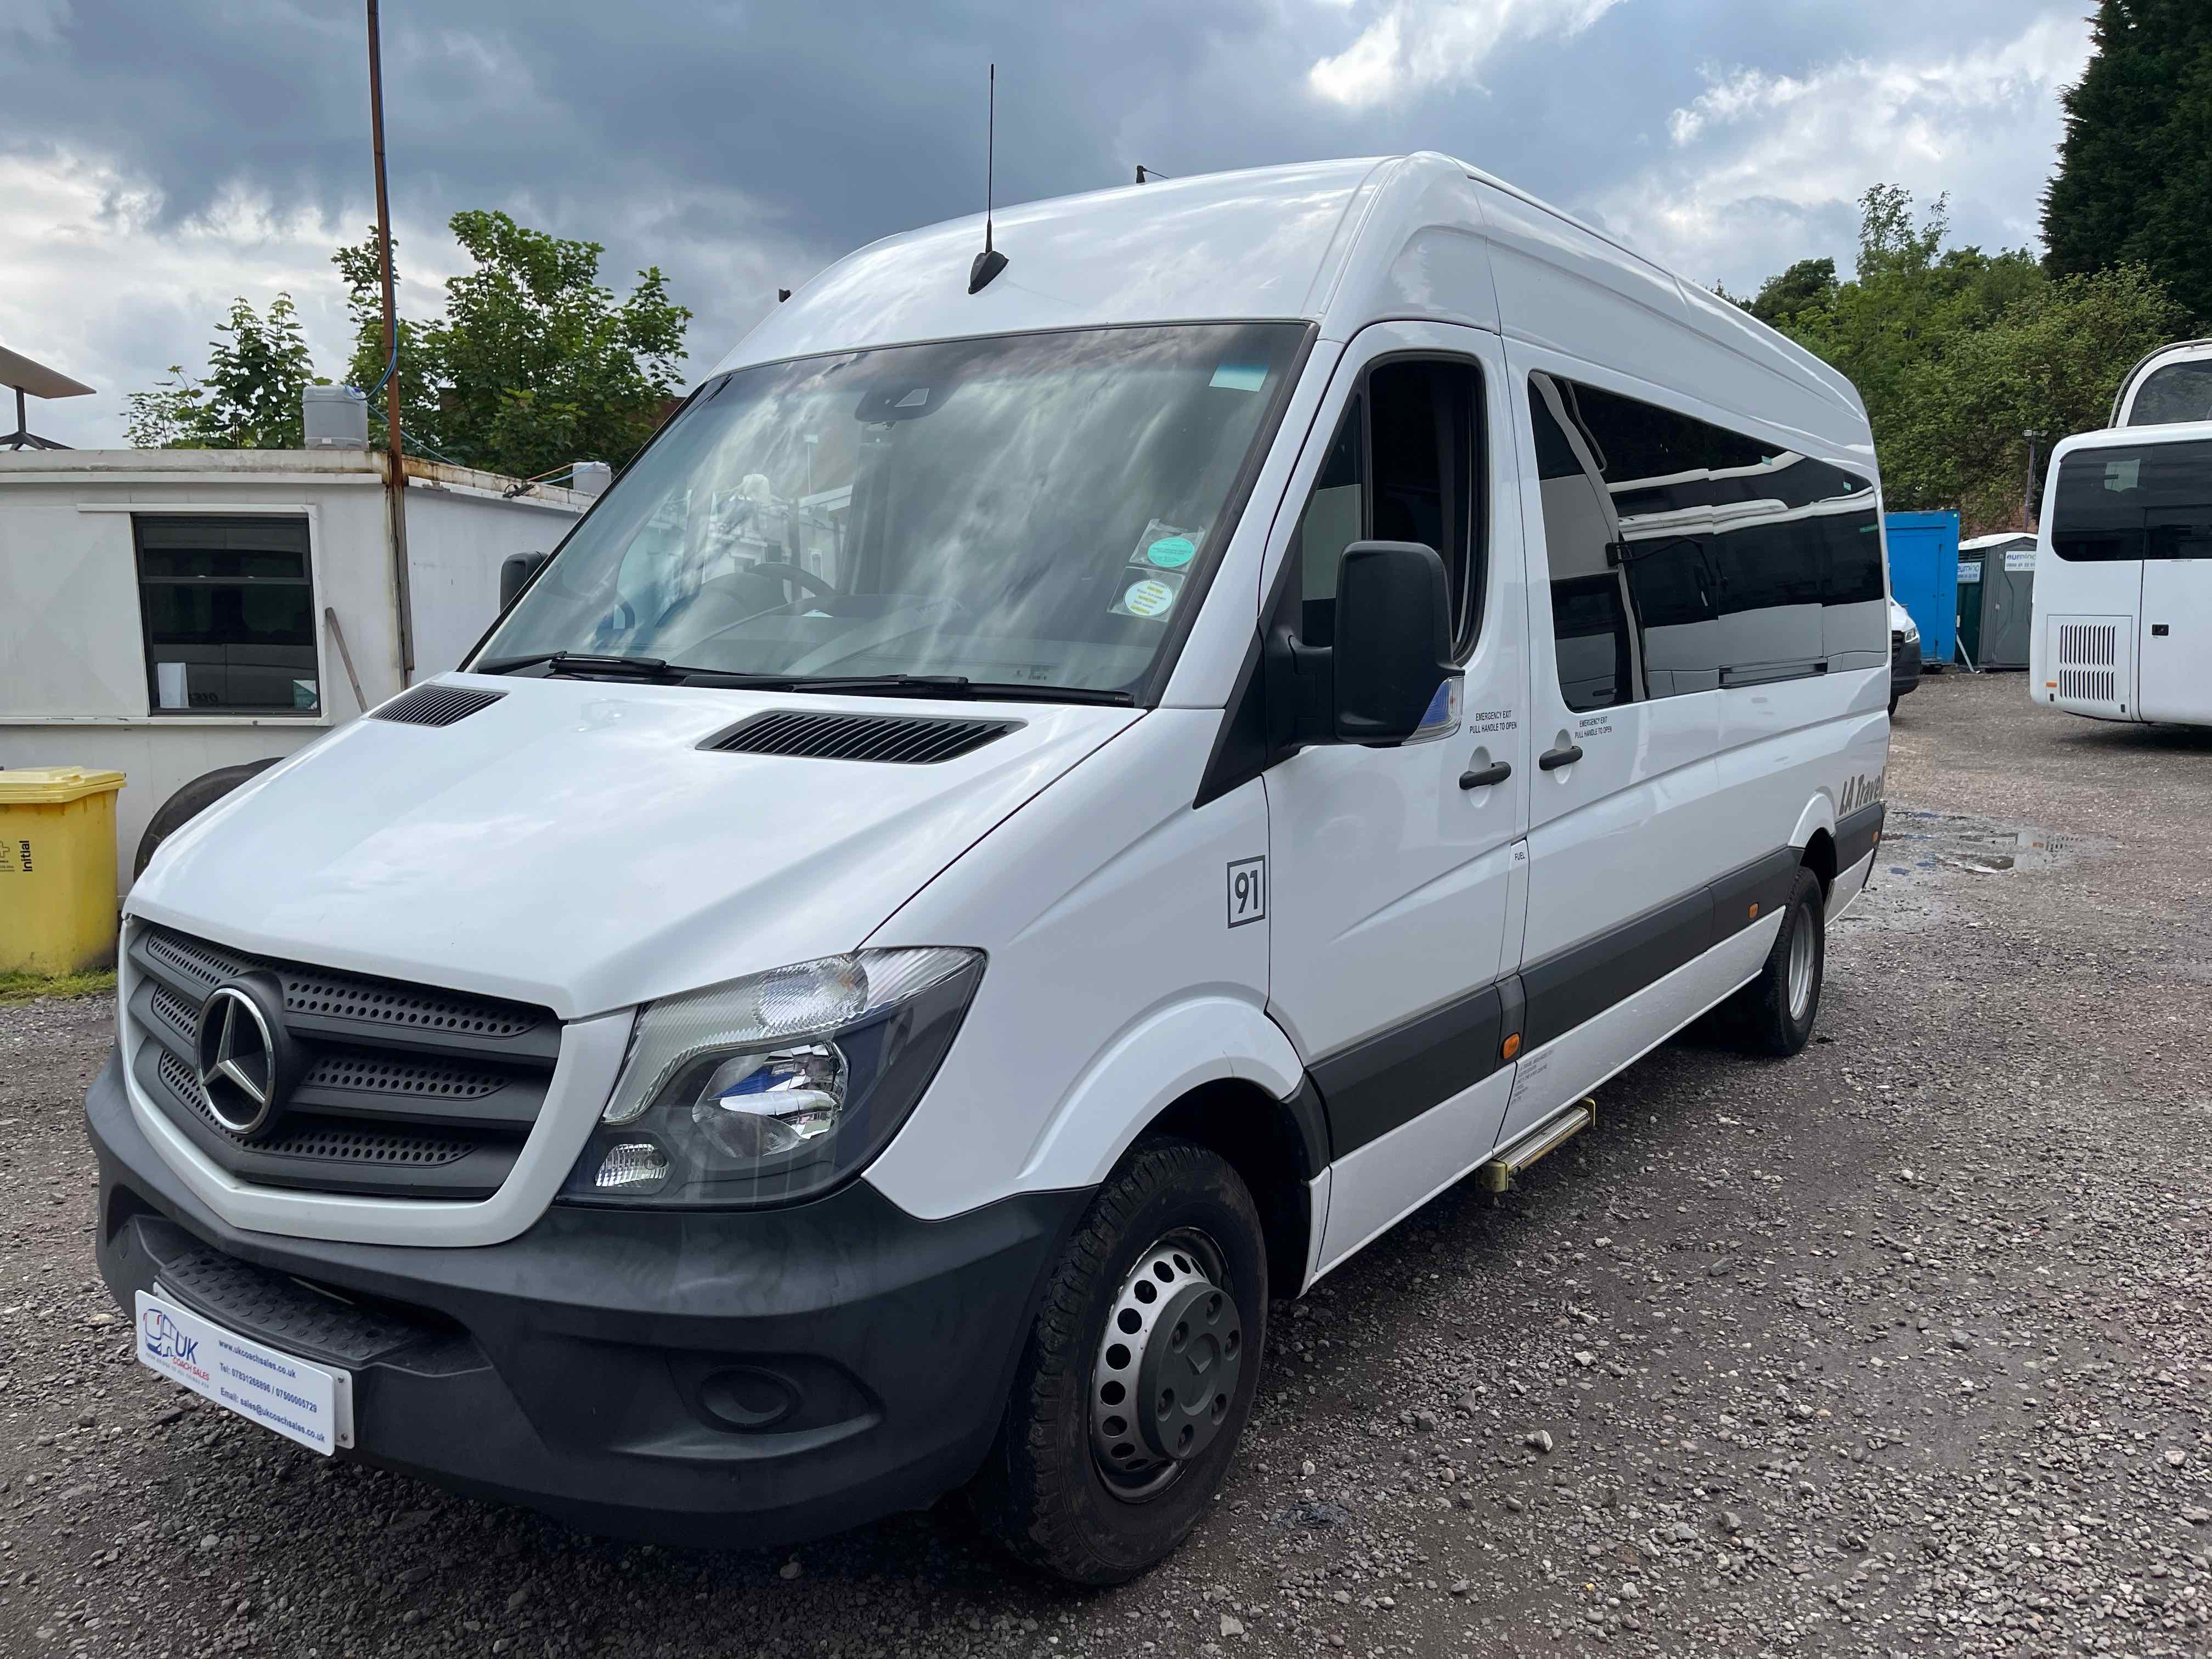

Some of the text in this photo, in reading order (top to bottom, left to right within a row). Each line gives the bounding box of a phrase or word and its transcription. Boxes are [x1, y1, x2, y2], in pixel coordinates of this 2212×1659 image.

[1475, 710, 1511, 721] EMERGENCY EXIT
[1579, 718, 1600, 727] EMERGENCY
[1470, 721, 1517, 733] PULL HANDLE TO OPEN
[1575, 730, 1584, 738] PULL
[1584, 729, 1598, 737] HANDLE
[19, 840, 33, 872] Initial
[1515, 851, 1525, 861] FUEL
[1234, 869, 1259, 914] 91
[176, 1330, 199, 1365] UK
[218, 1340, 296, 1378] www.ukcoachsales.co.uk
[173, 1357, 210, 1381] COACH SALES
[219, 1363, 230, 1374] Tel:
[221, 1387, 325, 1443] Email: sales@ukcoachsales.co.uk
